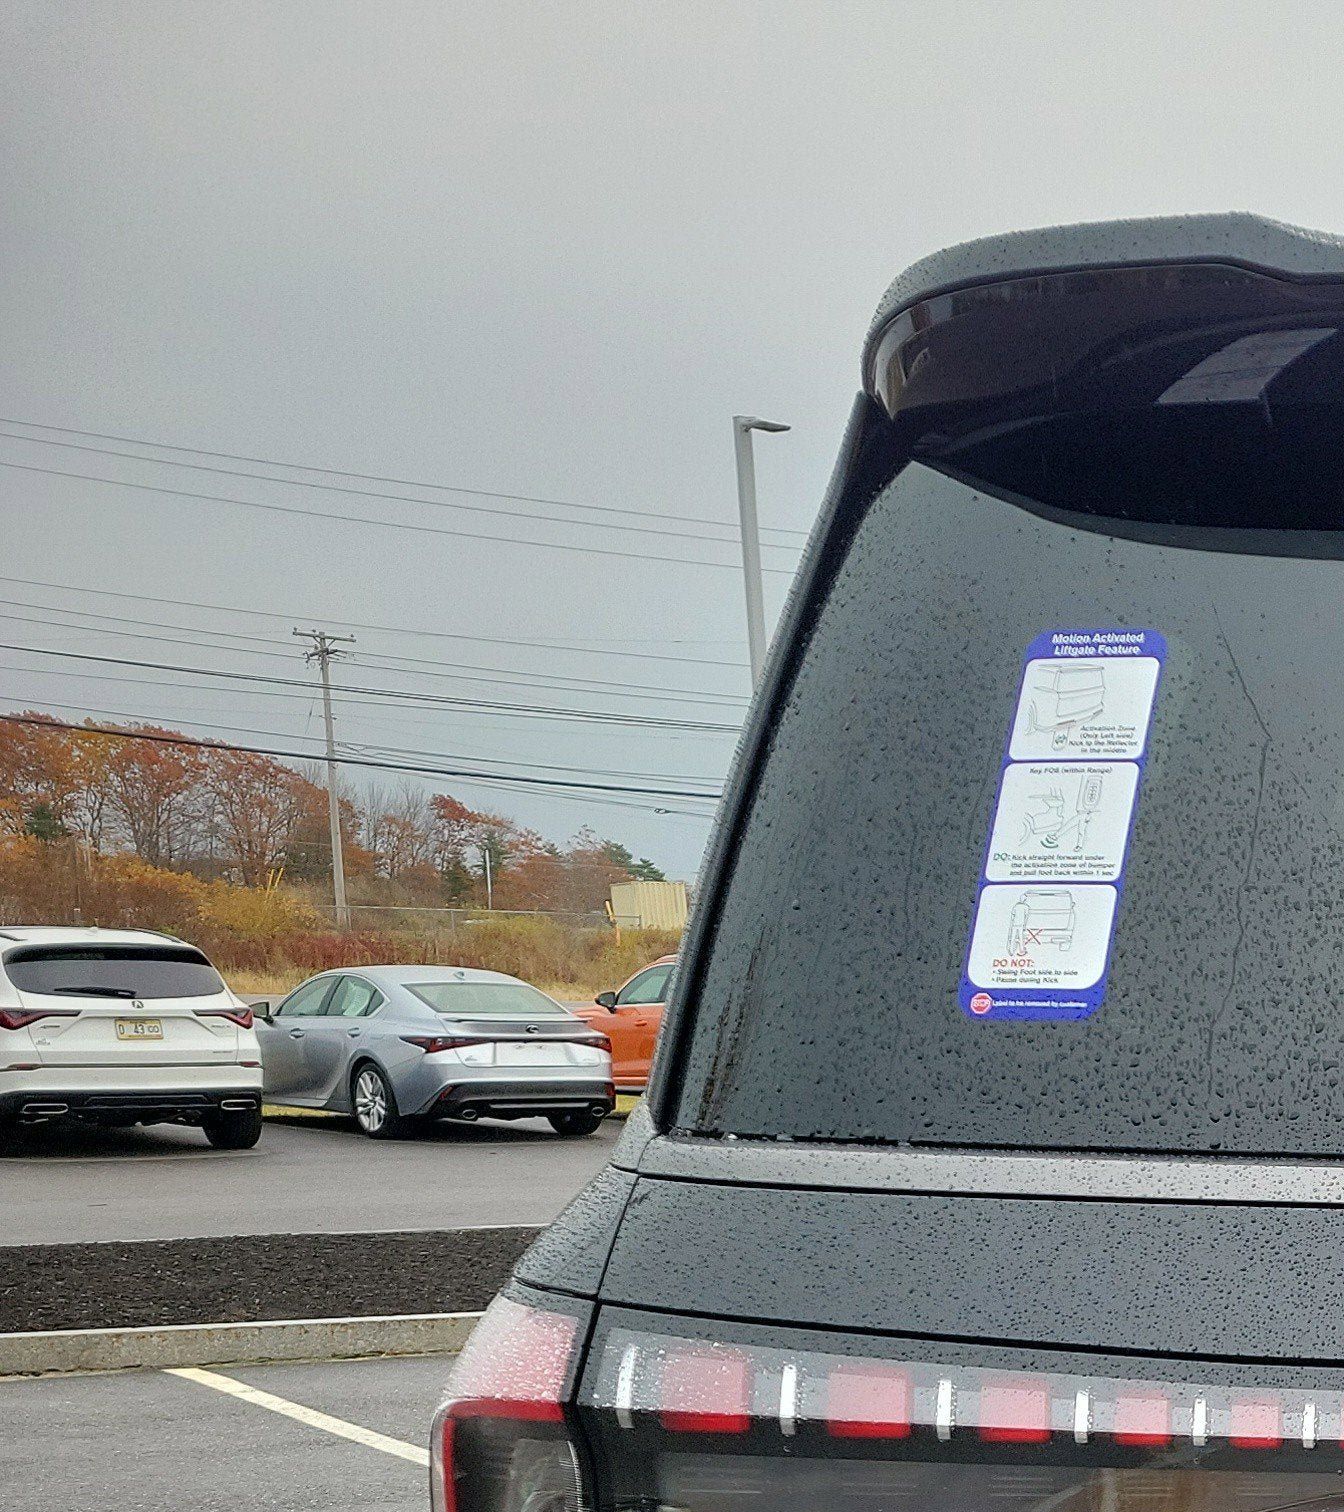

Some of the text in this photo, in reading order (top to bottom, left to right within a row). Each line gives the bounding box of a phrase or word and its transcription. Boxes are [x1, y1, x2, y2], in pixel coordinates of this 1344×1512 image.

[1051, 632, 1145, 644] Motion Activated
[1054, 644, 1142, 656] Liftgate Feature
[1086, 766, 1114, 775] Range)
[992, 853, 1012, 861] DO:
[1056, 853, 1083, 861] forward
[993, 958, 1035, 968] DO NOT:
